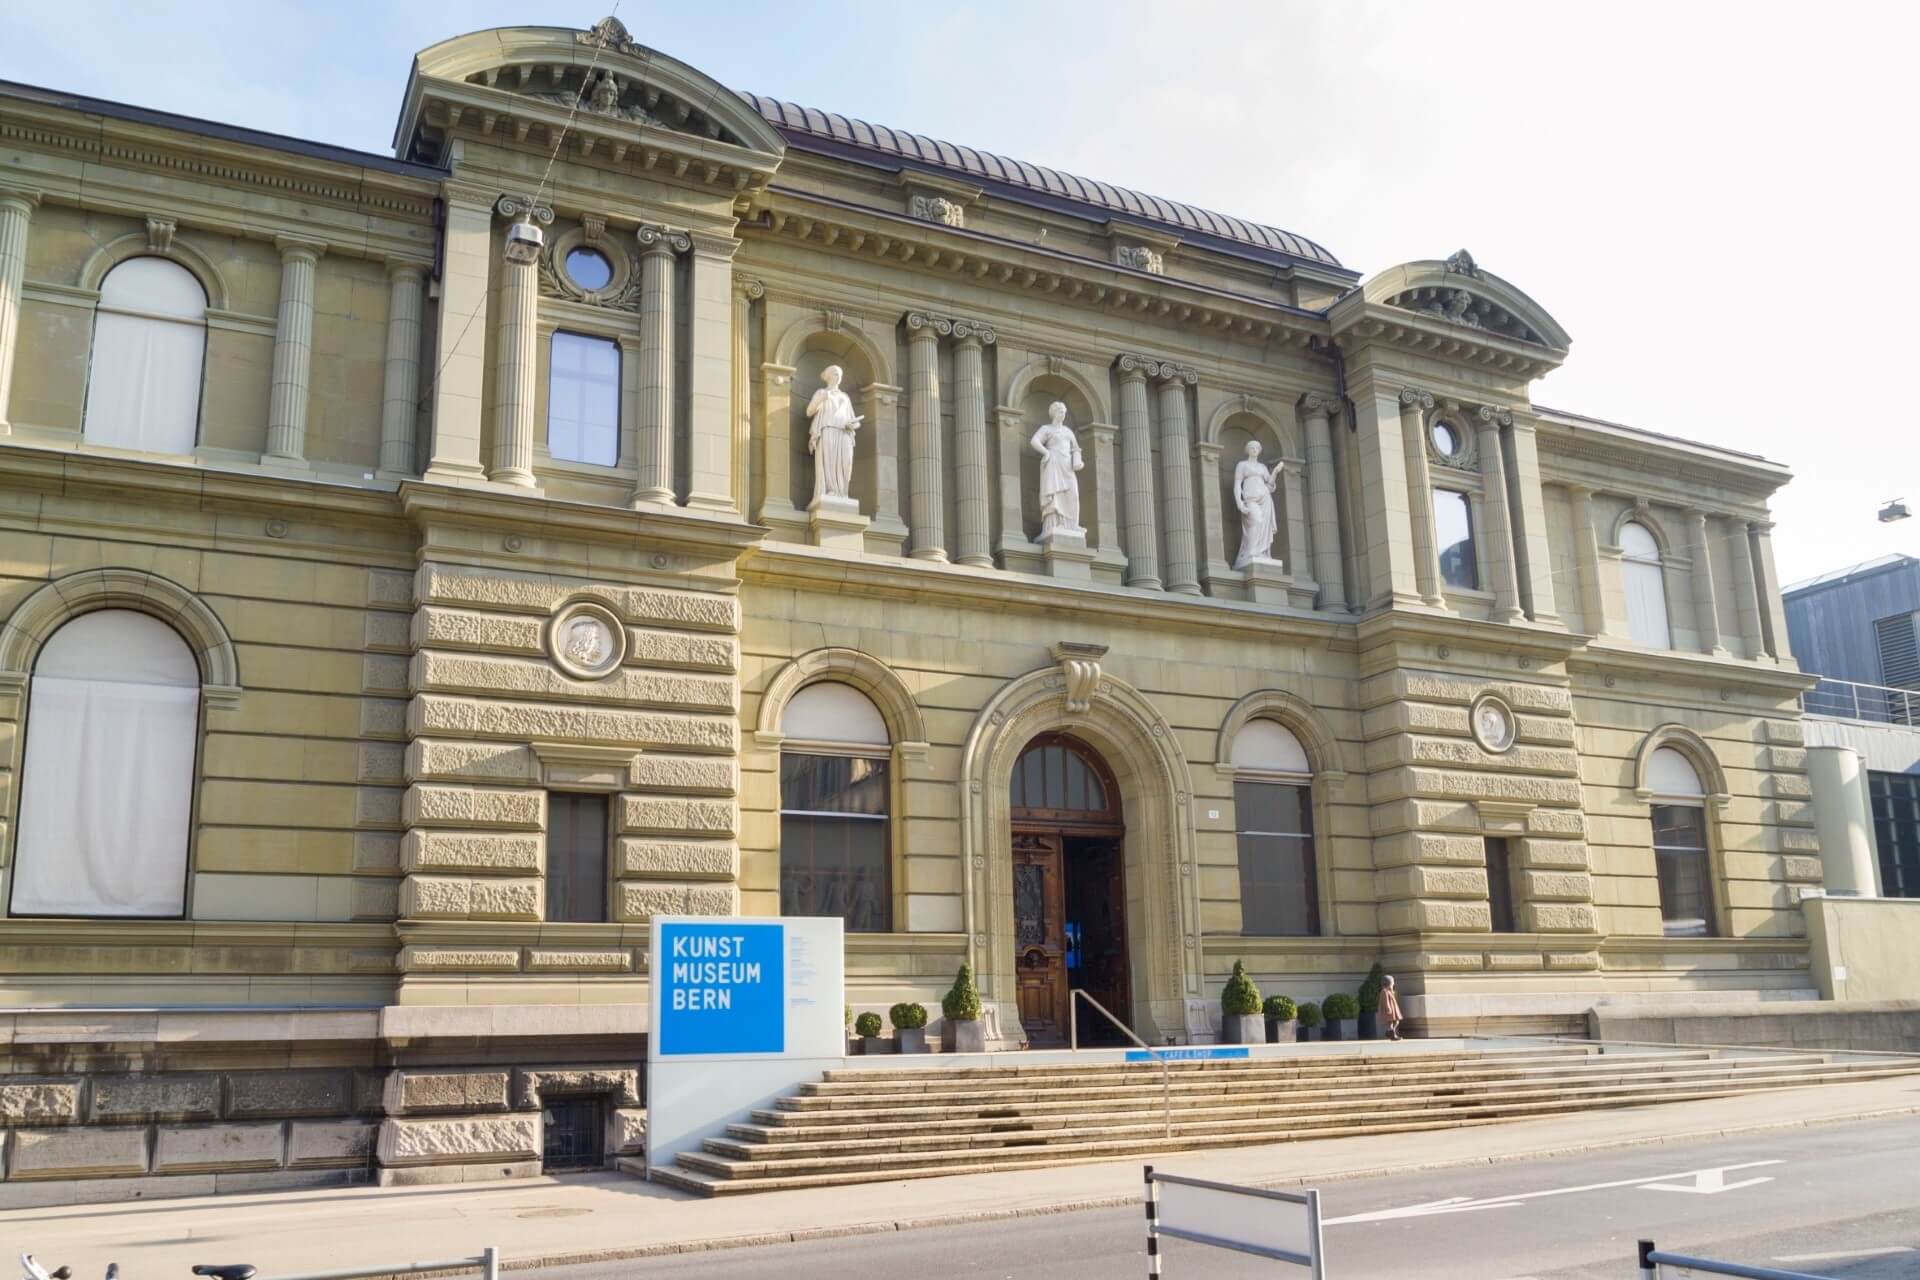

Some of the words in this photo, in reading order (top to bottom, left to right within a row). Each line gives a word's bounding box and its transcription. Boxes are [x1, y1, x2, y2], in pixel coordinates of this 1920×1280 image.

[673, 936, 744, 958] KUNST
[673, 962, 761, 984] MUSEUM
[673, 988, 731, 1010] BERN
